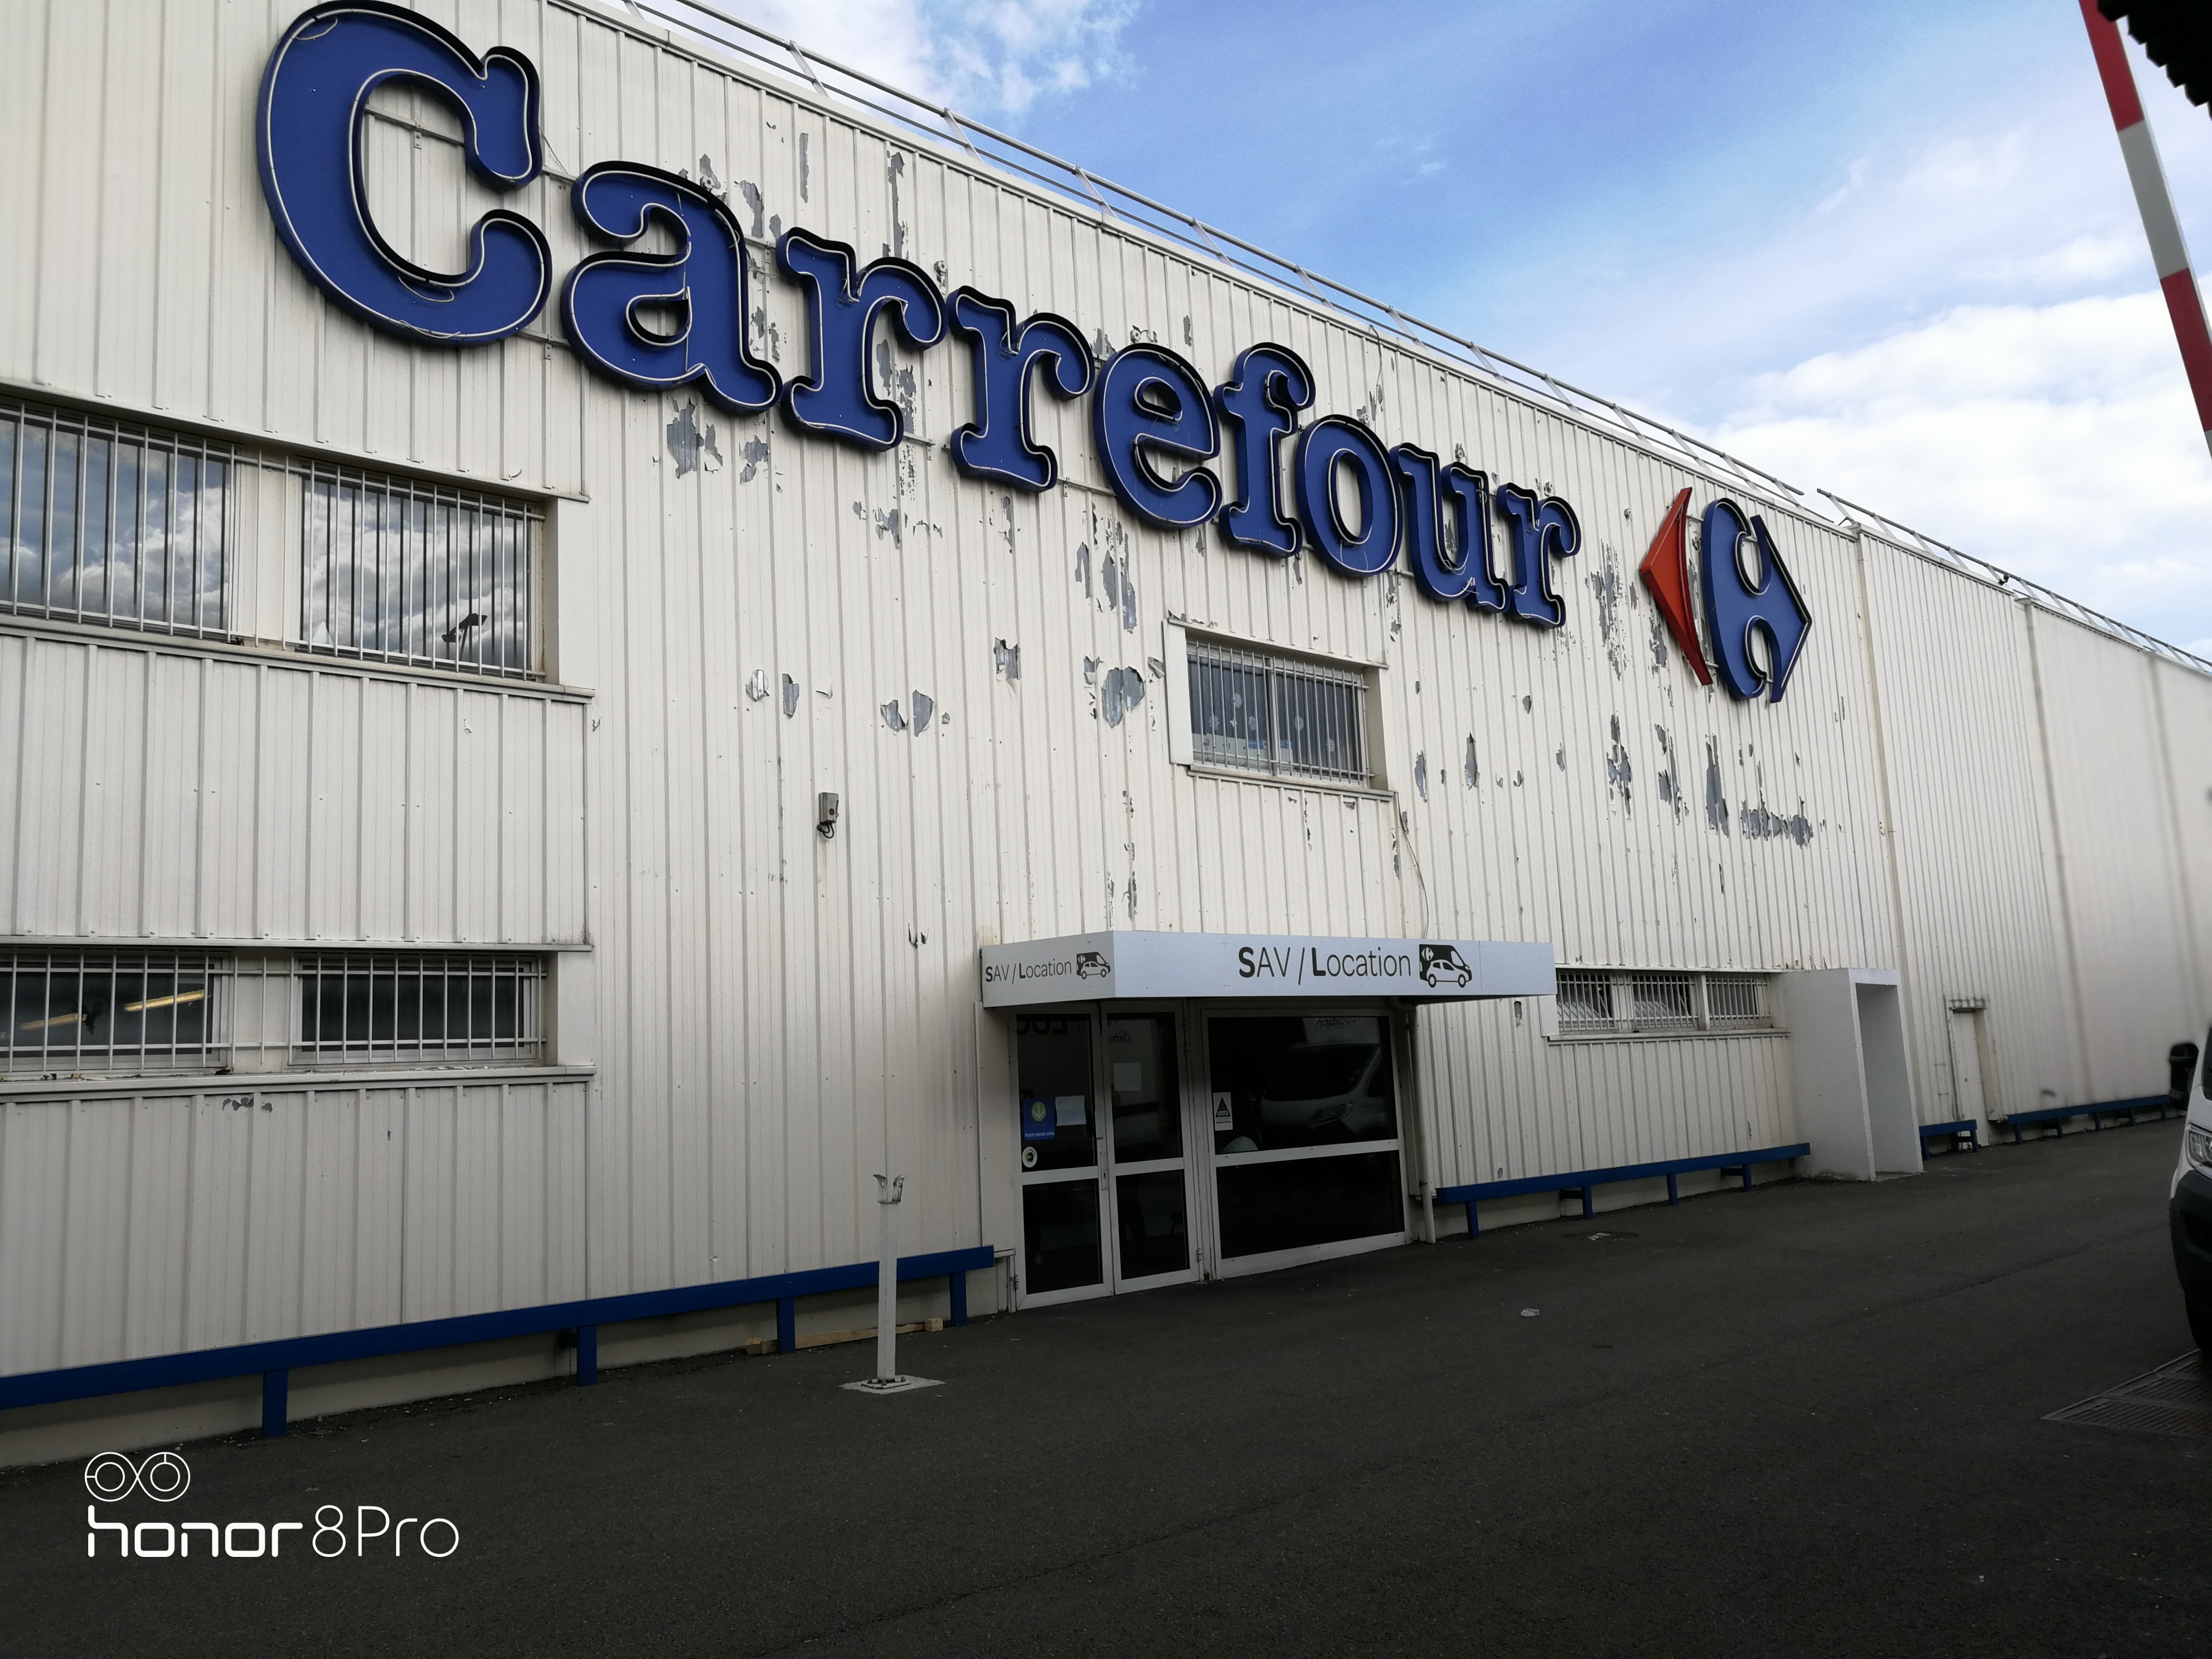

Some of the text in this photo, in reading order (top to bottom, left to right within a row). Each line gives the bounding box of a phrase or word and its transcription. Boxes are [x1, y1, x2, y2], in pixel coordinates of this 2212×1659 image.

[256, 1, 1580, 628] Carrefour
[985, 964, 1010, 983] SAV
[1018, 959, 1072, 979] Location
[1238, 947, 1291, 978] SAV
[1311, 947, 1411, 977] Location
